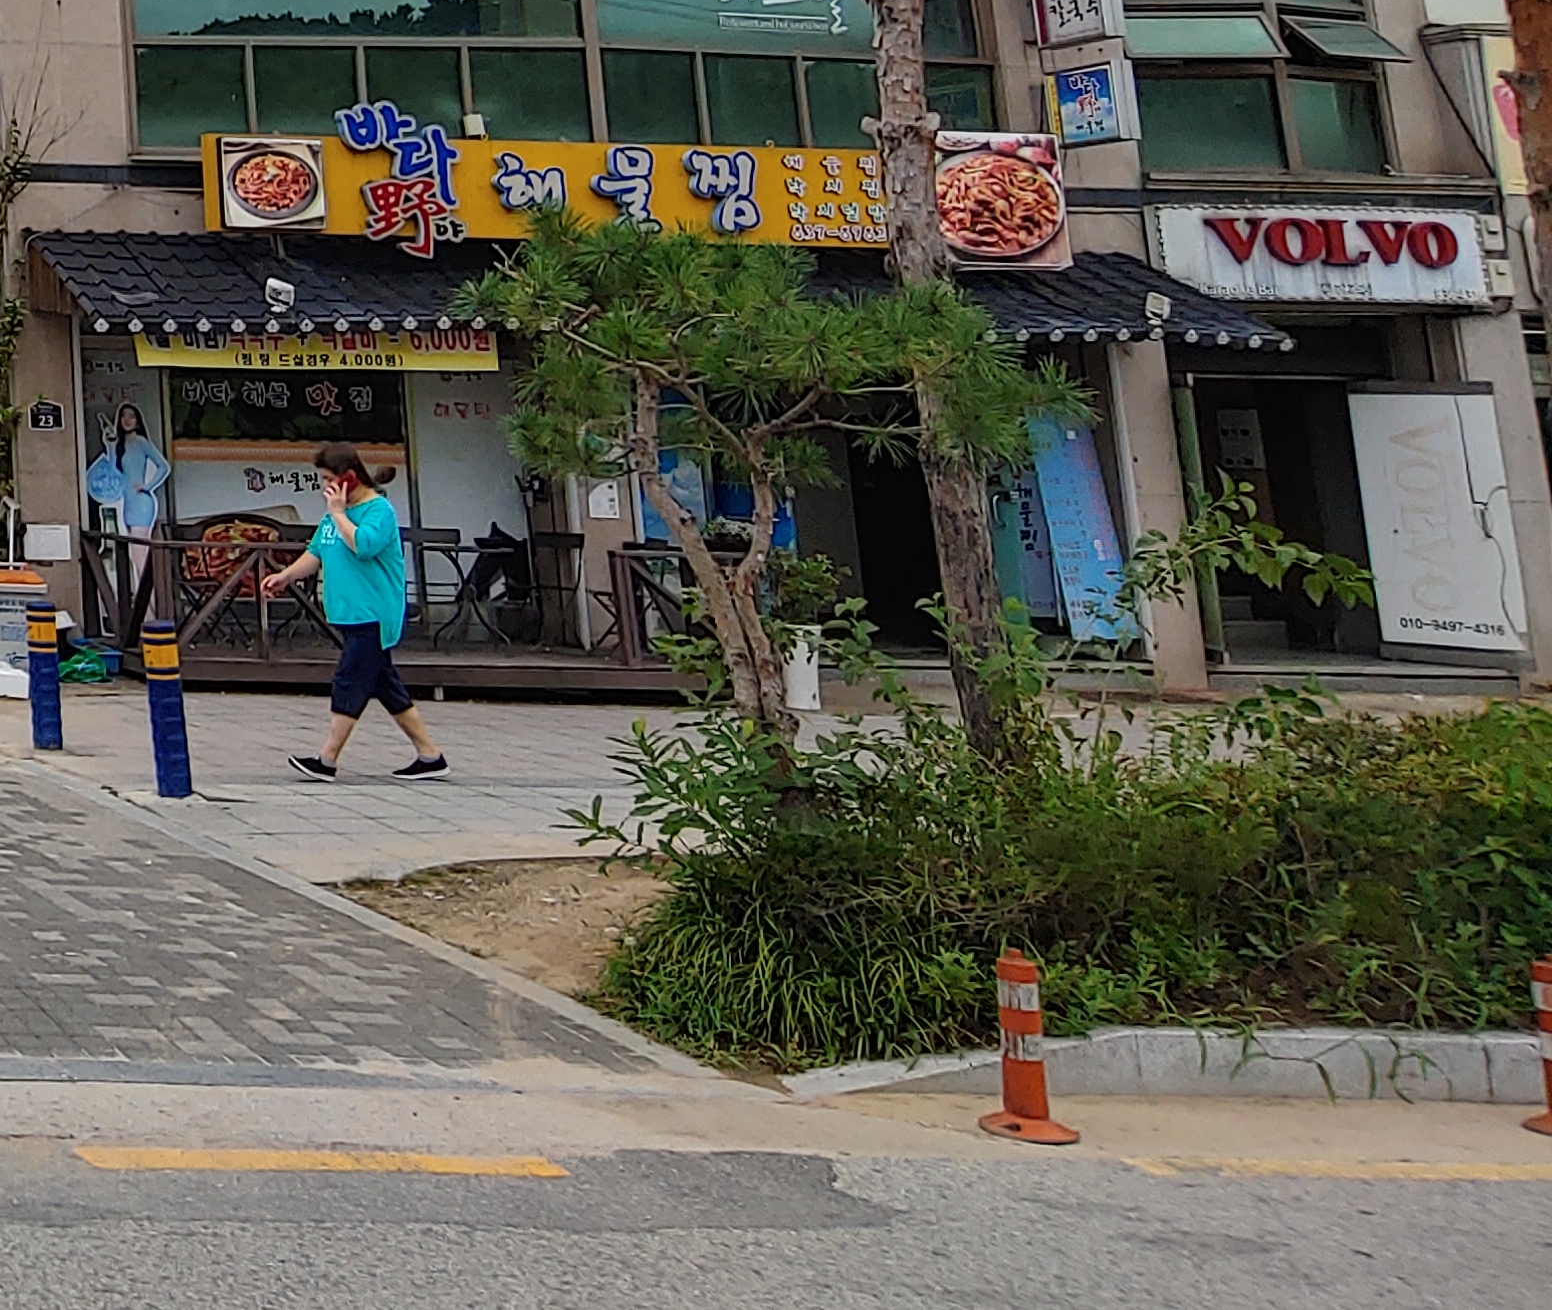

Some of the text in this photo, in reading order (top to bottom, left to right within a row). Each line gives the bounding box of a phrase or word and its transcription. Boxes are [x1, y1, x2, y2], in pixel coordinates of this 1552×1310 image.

[335, 100, 460, 206] 바다
[492, 145, 762, 235] 해물찜
[362, 177, 447, 259] 野
[1203, 217, 1459, 269] VOLVO
[182, 380, 232, 406] 바다
[243, 381, 290, 408] 해물
[38, 415, 54, 427] 23
[269, 471, 321, 493] 해물찜
